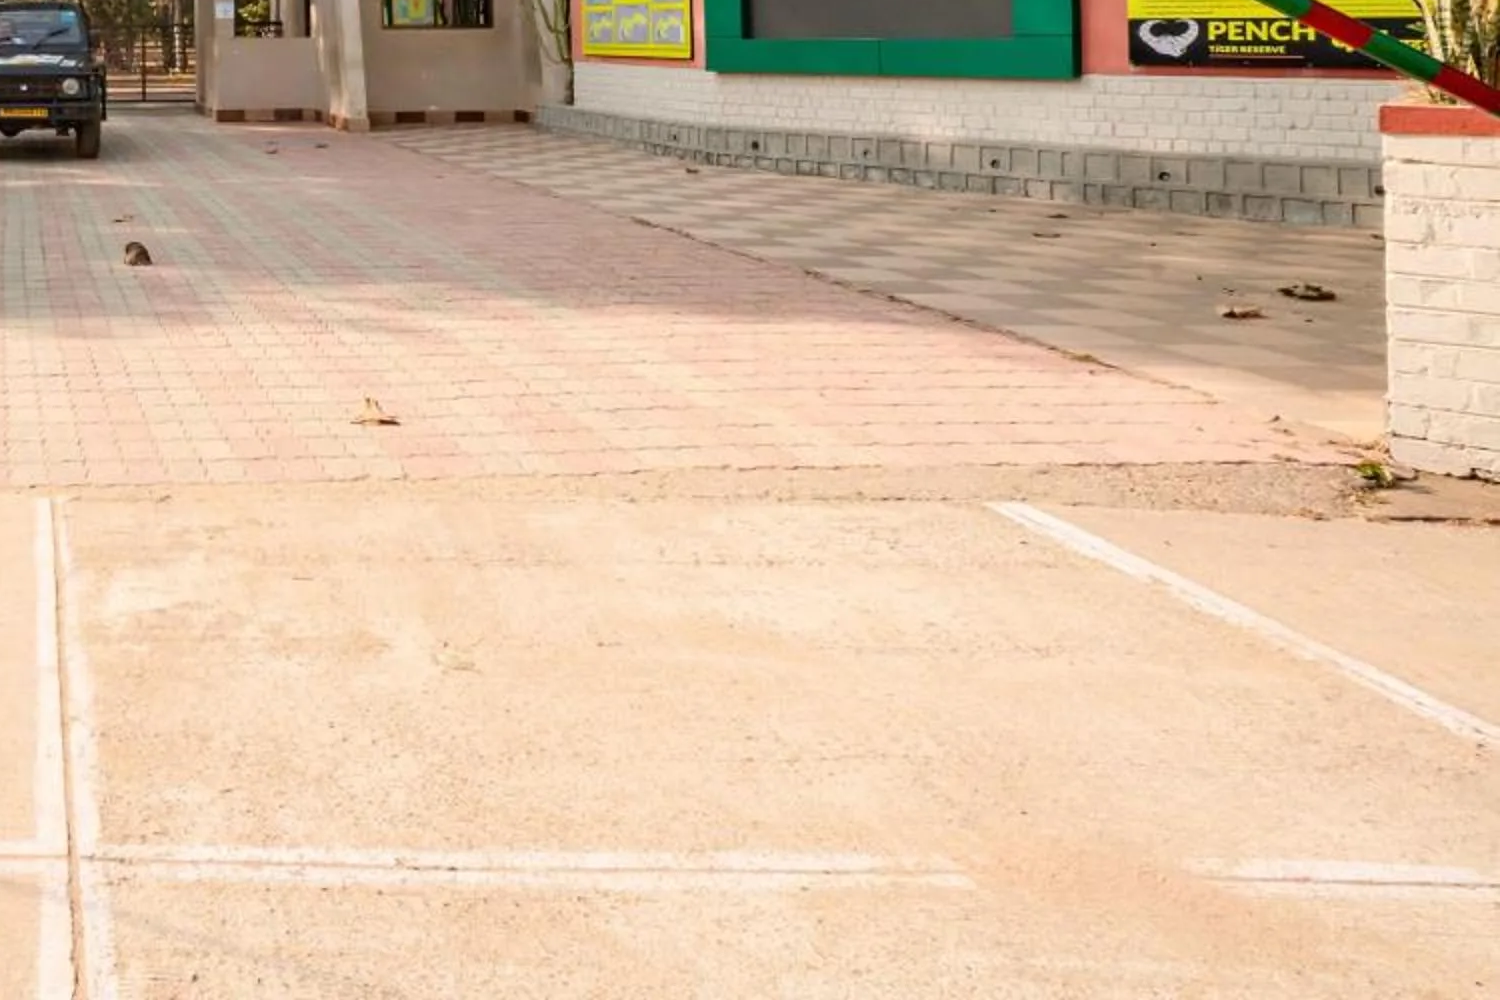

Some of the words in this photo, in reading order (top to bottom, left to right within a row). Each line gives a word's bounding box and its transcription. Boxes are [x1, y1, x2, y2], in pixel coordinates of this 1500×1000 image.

[1207, 20, 1317, 42] PENCH
[1208, 44, 1239, 54] TIGER
[1240, 44, 1287, 54] RESERVE
